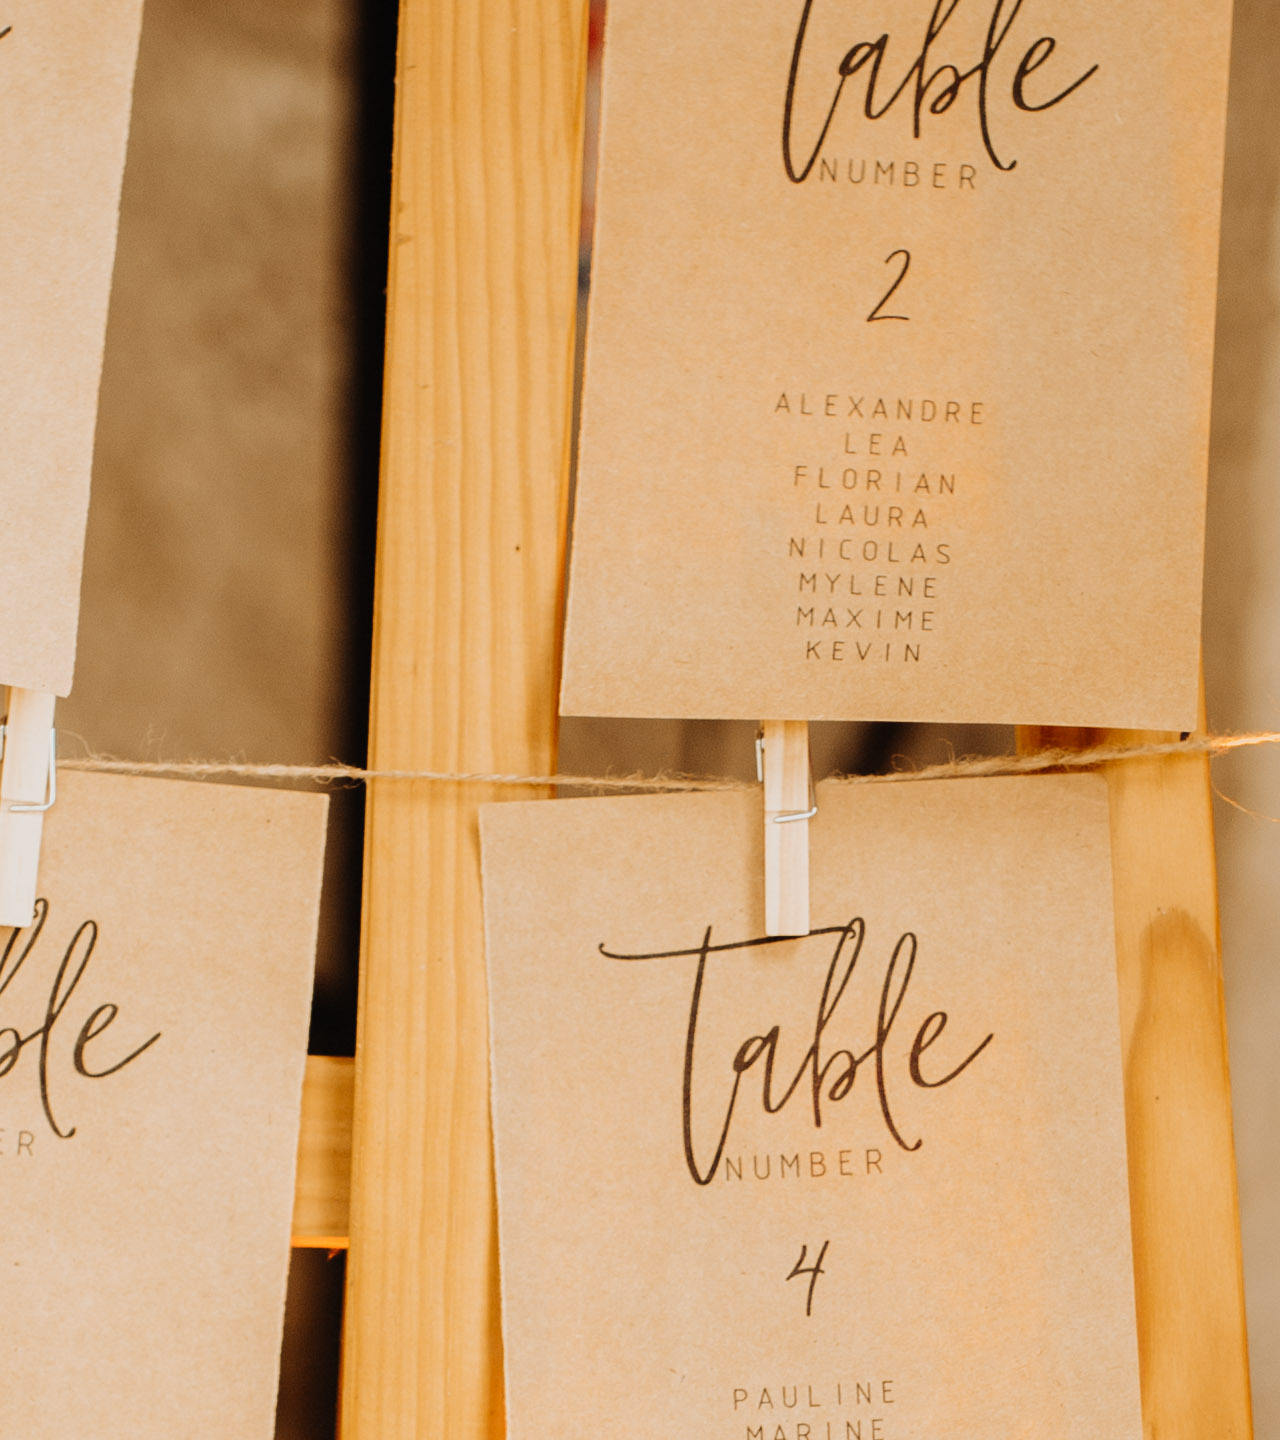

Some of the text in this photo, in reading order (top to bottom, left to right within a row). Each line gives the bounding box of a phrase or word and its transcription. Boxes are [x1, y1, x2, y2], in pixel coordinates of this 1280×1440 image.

[818, 156, 979, 190] NUMBER
[865, 249, 911, 324] 2
[775, 392, 984, 426] ALEXANDRE
[844, 433, 908, 456] LEA
[794, 465, 955, 495] FLORIAN
[815, 504, 928, 528] LAURA
[788, 537, 951, 565] NICOLAS
[799, 572, 936, 599] MYLENE
[796, 607, 934, 631] MAXIME
[806, 640, 920, 662] KEVIN
[723, 1148, 884, 1183] NUMBER
[785, 1240, 830, 1316] 4
[733, 1380, 895, 1411] PAULINE
